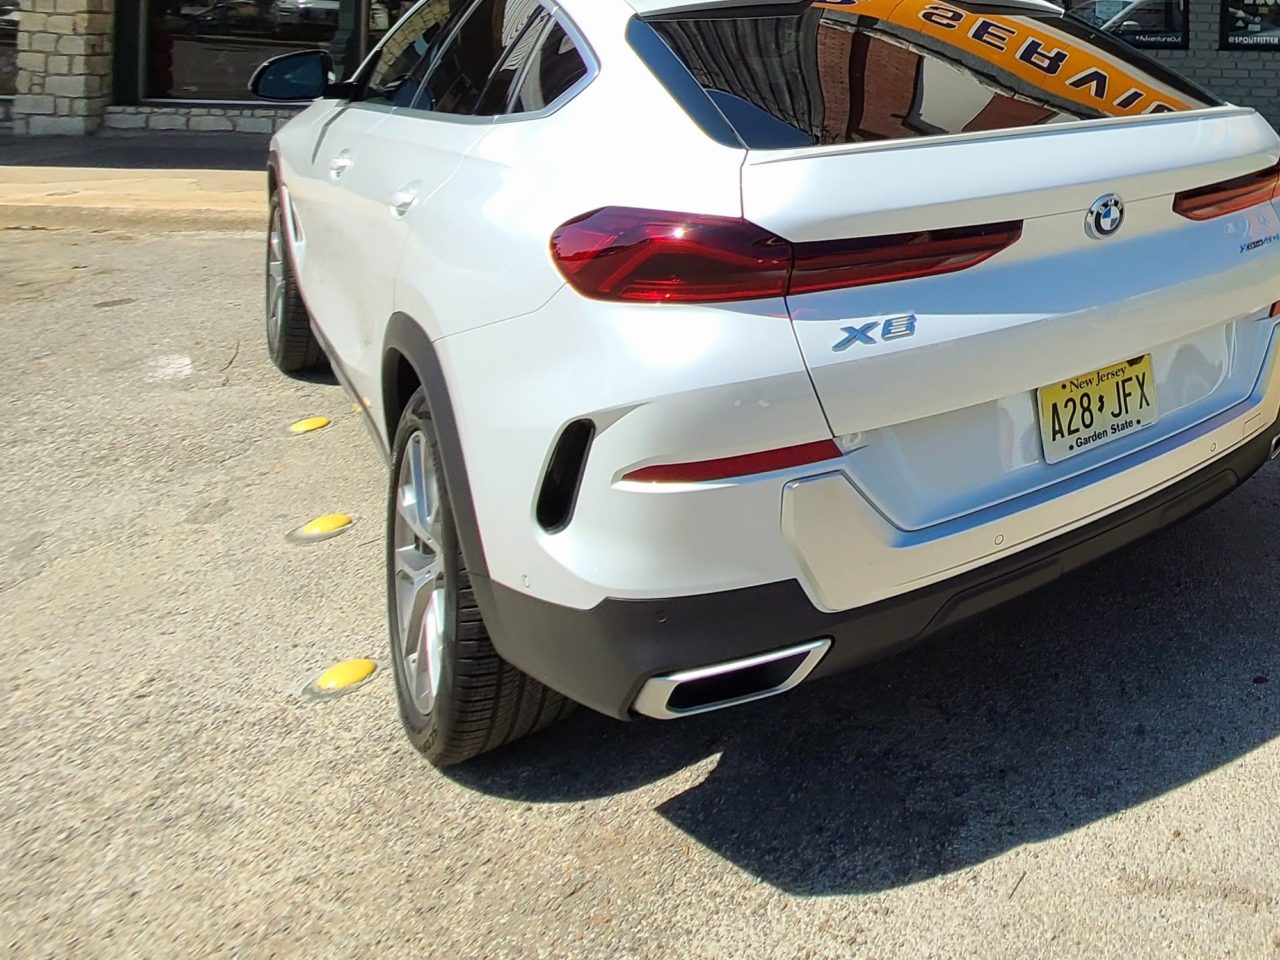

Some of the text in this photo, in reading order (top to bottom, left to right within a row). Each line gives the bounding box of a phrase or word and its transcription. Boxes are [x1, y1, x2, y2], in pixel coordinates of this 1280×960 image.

[1228, 36, 1279, 44] @SPOUTFITTER
[832, 314, 917, 352] X6
[1069, 366, 1127, 393] New Jersey
[1051, 372, 1151, 442] A28 JFX
[1075, 420, 1134, 448] Garden State
